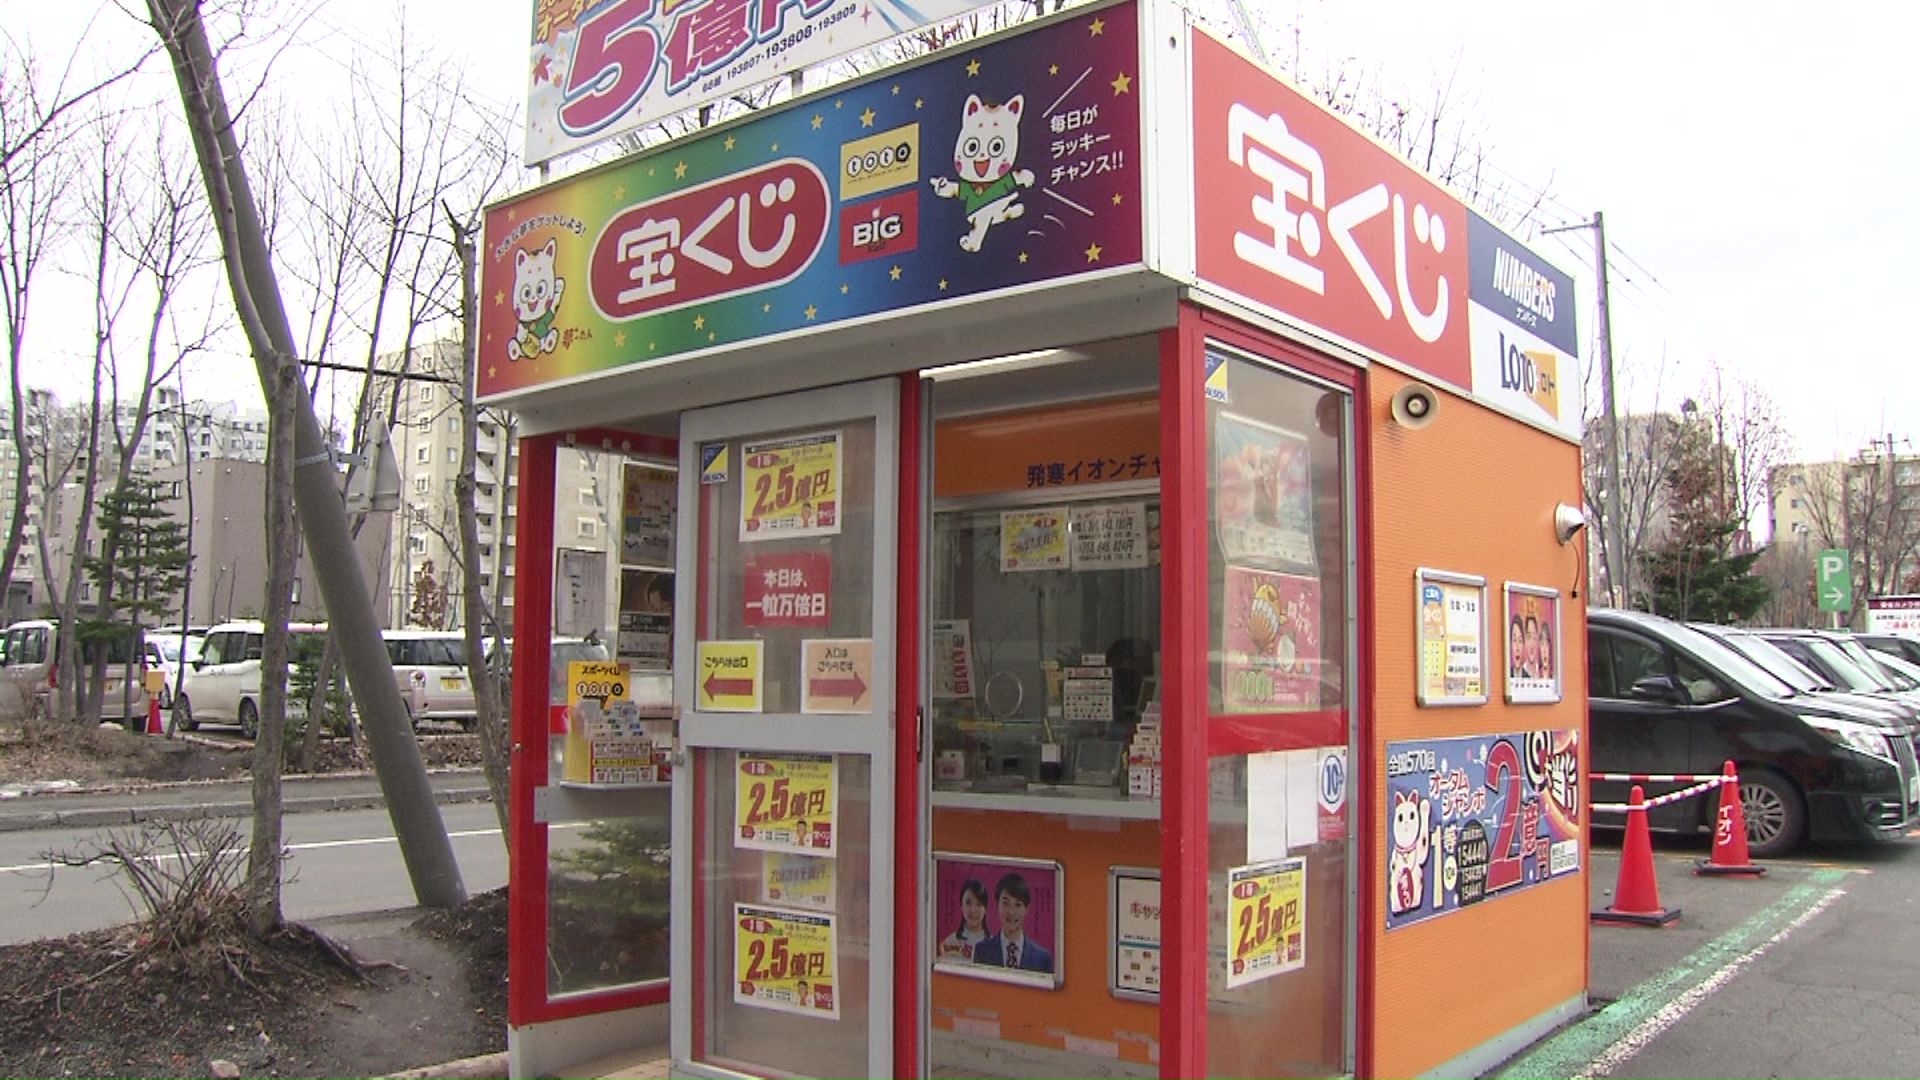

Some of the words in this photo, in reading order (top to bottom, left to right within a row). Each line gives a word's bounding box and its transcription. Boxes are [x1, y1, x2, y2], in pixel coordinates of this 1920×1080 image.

[1050, 105, 1099, 133] 毎日が
[847, 142, 912, 177] toto
[1051, 134, 1111, 159] ラッキー
[1051, 151, 1123, 185] チャンス!!
[853, 214, 903, 247] BIG
[1228, 102, 1450, 342] 宝くじ
[617, 177, 796, 304] 宝くじ
[1493, 247, 1556, 323] NUMBERS
[1499, 330, 1535, 395] LOTO
[1823, 557, 1844, 581] P
[746, 593, 826, 617] 一粒万倍日
[1429, 768, 1470, 798] オータム
[747, 777, 826, 825] 2.5億円
[1718, 804, 1733, 847] イオン
[746, 937, 825, 980] 2.5億円
